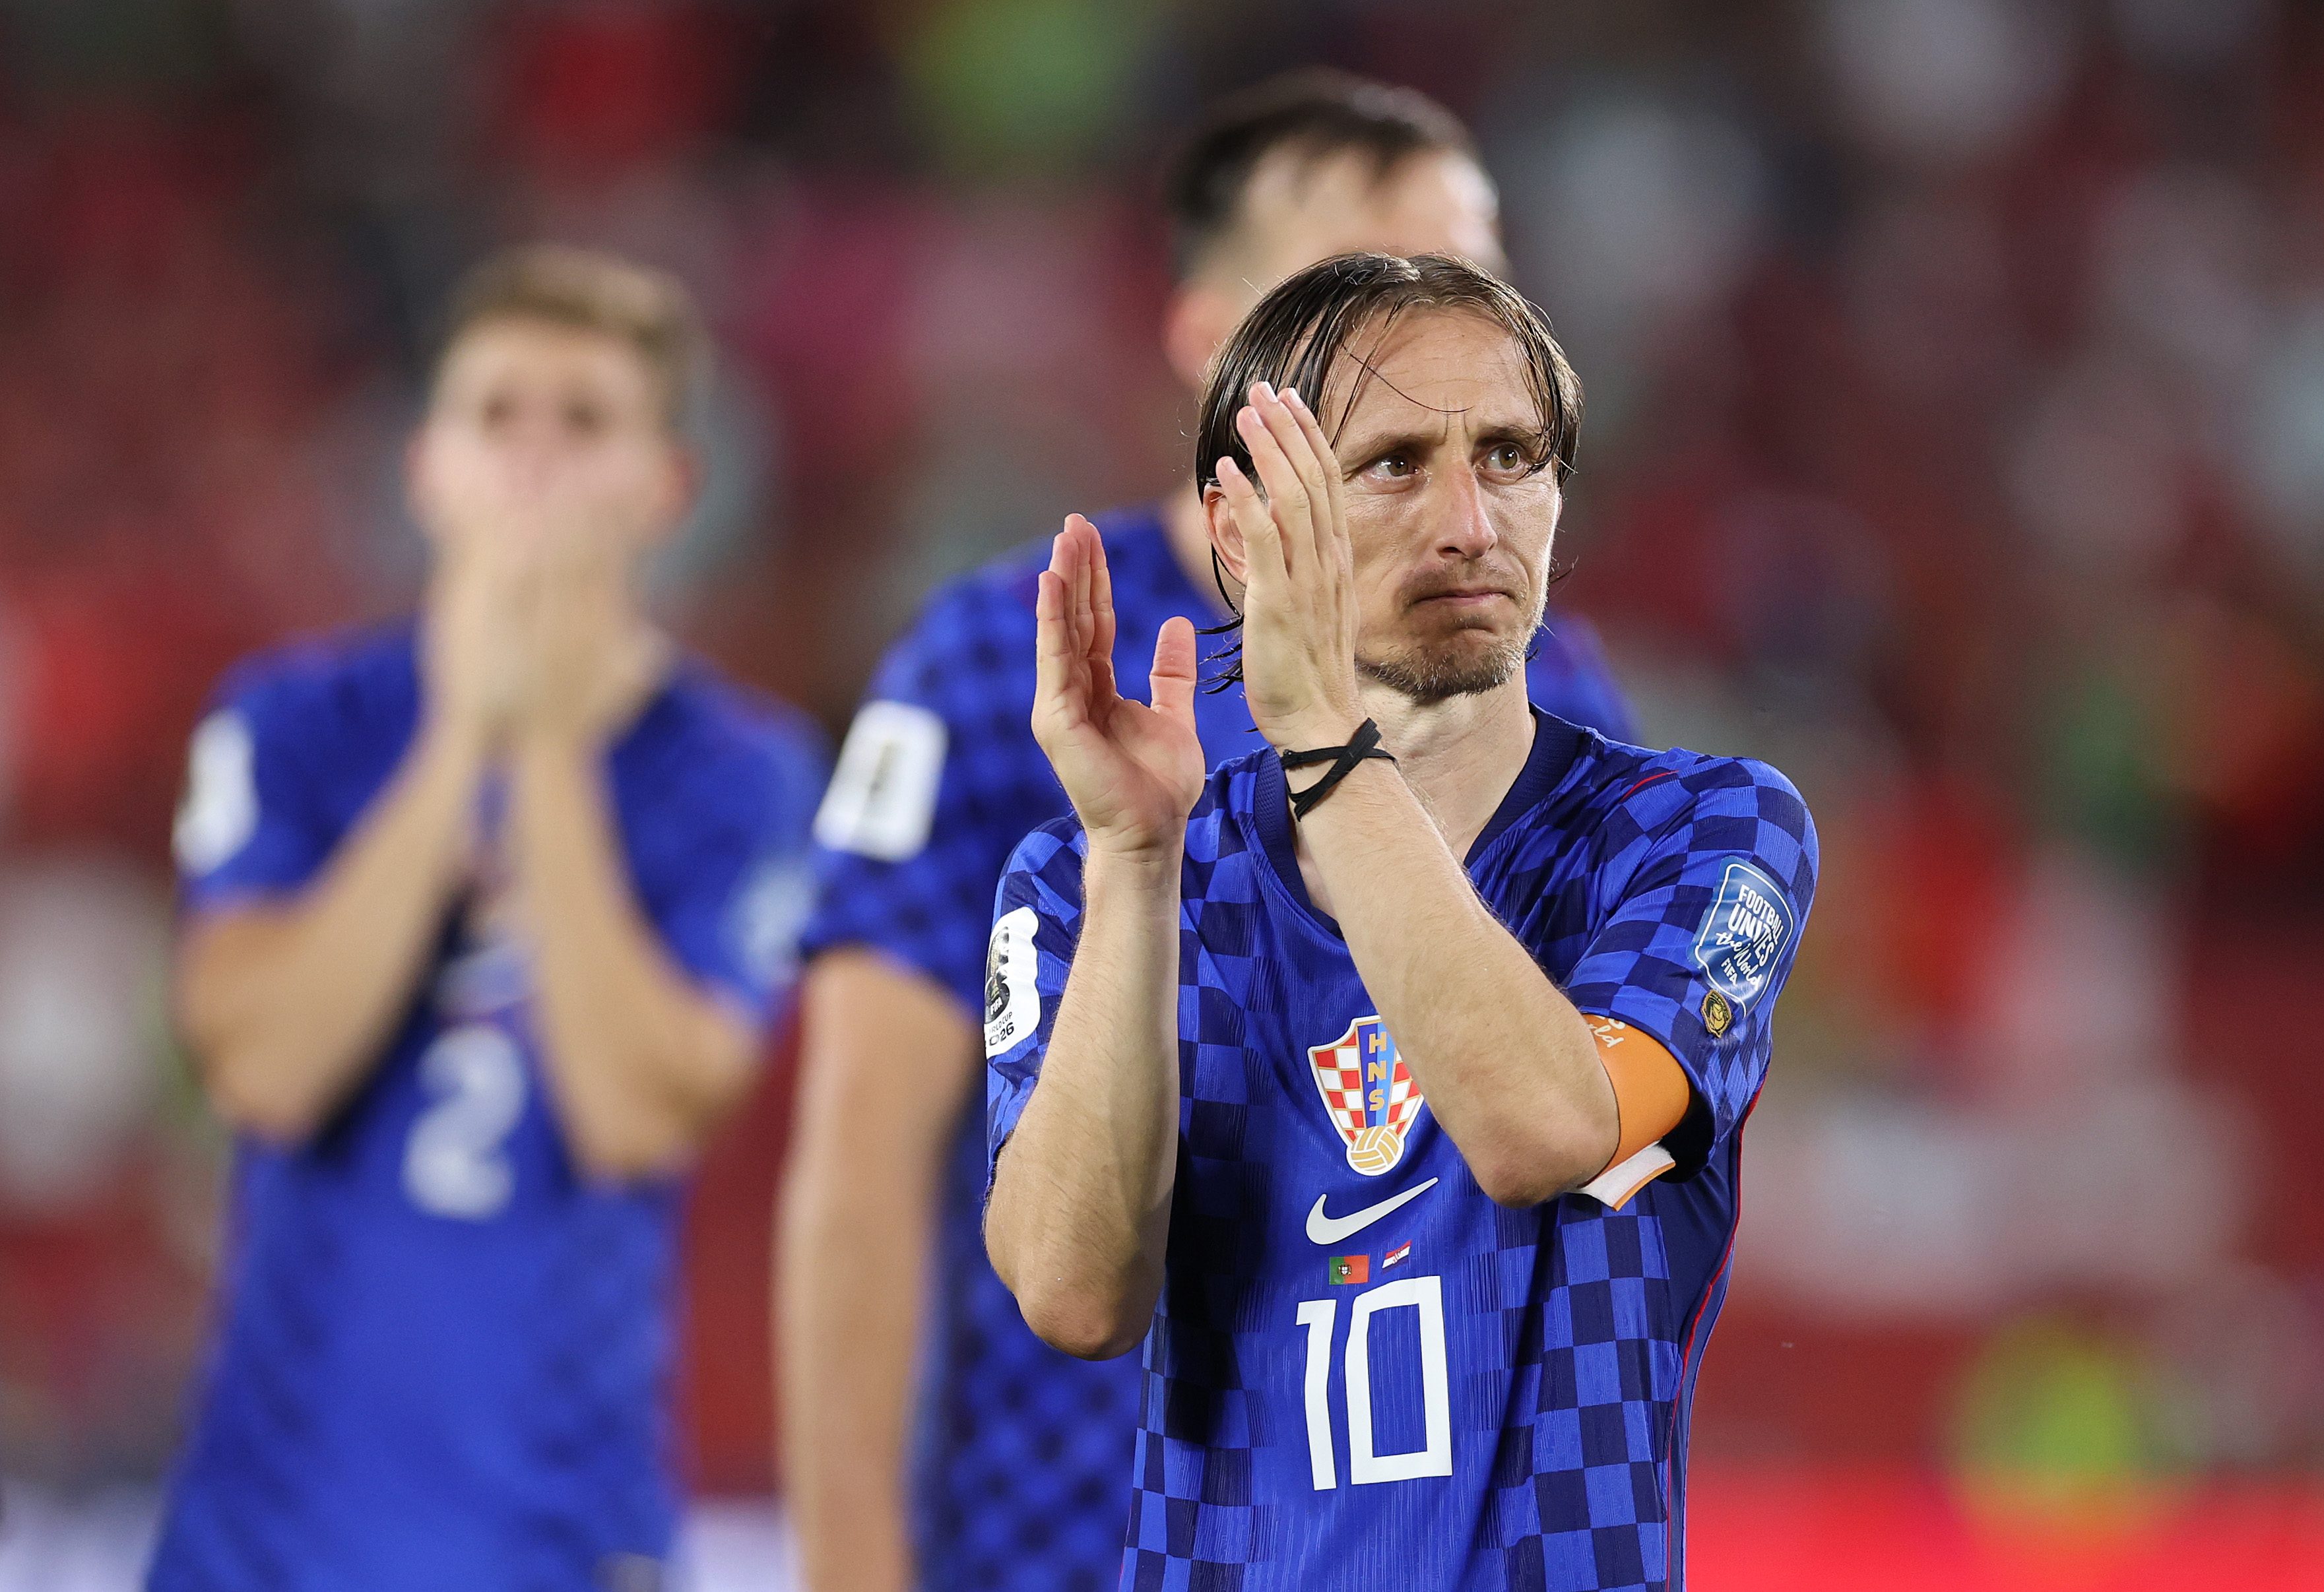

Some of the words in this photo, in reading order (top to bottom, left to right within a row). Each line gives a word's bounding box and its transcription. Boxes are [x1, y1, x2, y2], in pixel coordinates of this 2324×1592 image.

[1727, 903, 1774, 967] UNITES
[1738, 884, 1784, 945] FOOTBALL
[1716, 932, 1742, 951] the
[1734, 943, 1762, 991] World
[1721, 957, 1738, 986] FIFA
[986, 1022, 1014, 1046] 026
[988, 1021, 1002, 1035] RLD
[1002, 1011, 1013, 1025] CUP
[990, 996, 1003, 1015] FIFA
[1368, 1031, 1387, 1111] HNS
[401, 1018, 527, 1221] 2
[1296, 1275, 1452, 1490] 10
